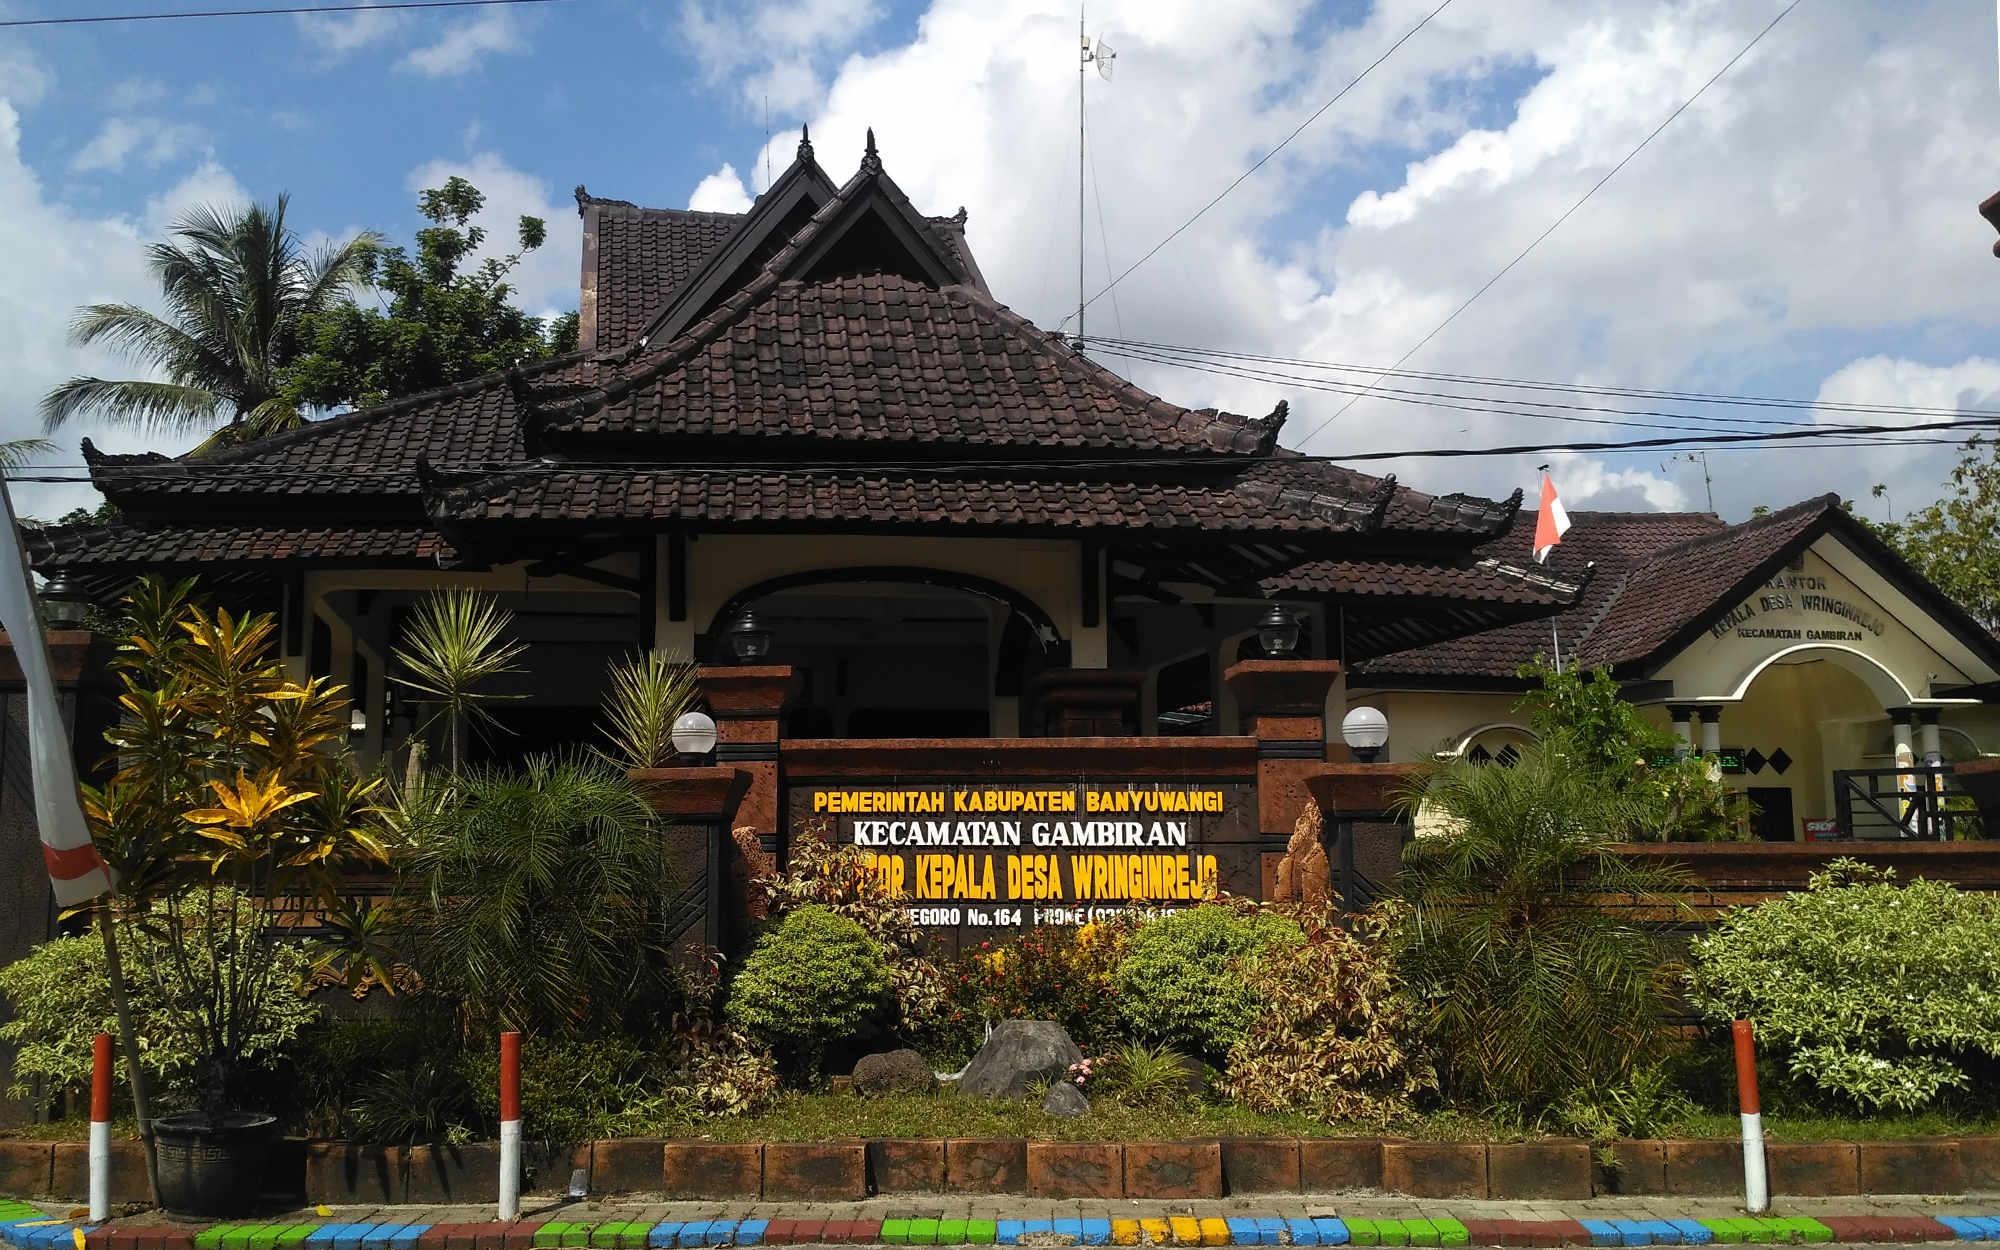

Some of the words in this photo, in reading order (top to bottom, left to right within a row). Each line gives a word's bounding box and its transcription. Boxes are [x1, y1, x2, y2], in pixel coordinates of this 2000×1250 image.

[1710, 603, 1756, 639] KEPALA
[1759, 594, 1794, 613] DESA
[1801, 594, 1886, 637] WRINGINREJO
[1737, 628, 1801, 640] KECAMATAN
[1806, 629, 1862, 641] GAMBIRAN
[814, 791, 945, 813] PEMERINTAH
[954, 791, 1075, 812] KABUPATEN
[1086, 791, 1224, 812] BANYUWANGI
[854, 822, 1021, 846] KECAMATAN
[1032, 822, 1187, 847] GAMBIRAN
[916, 854, 997, 900] KEPALA
[1007, 855, 1063, 899] DESA
[1071, 854, 1218, 900] WRINGINREJO
[904, 908, 961, 926] EGORO
[967, 908, 1022, 926] No.164
